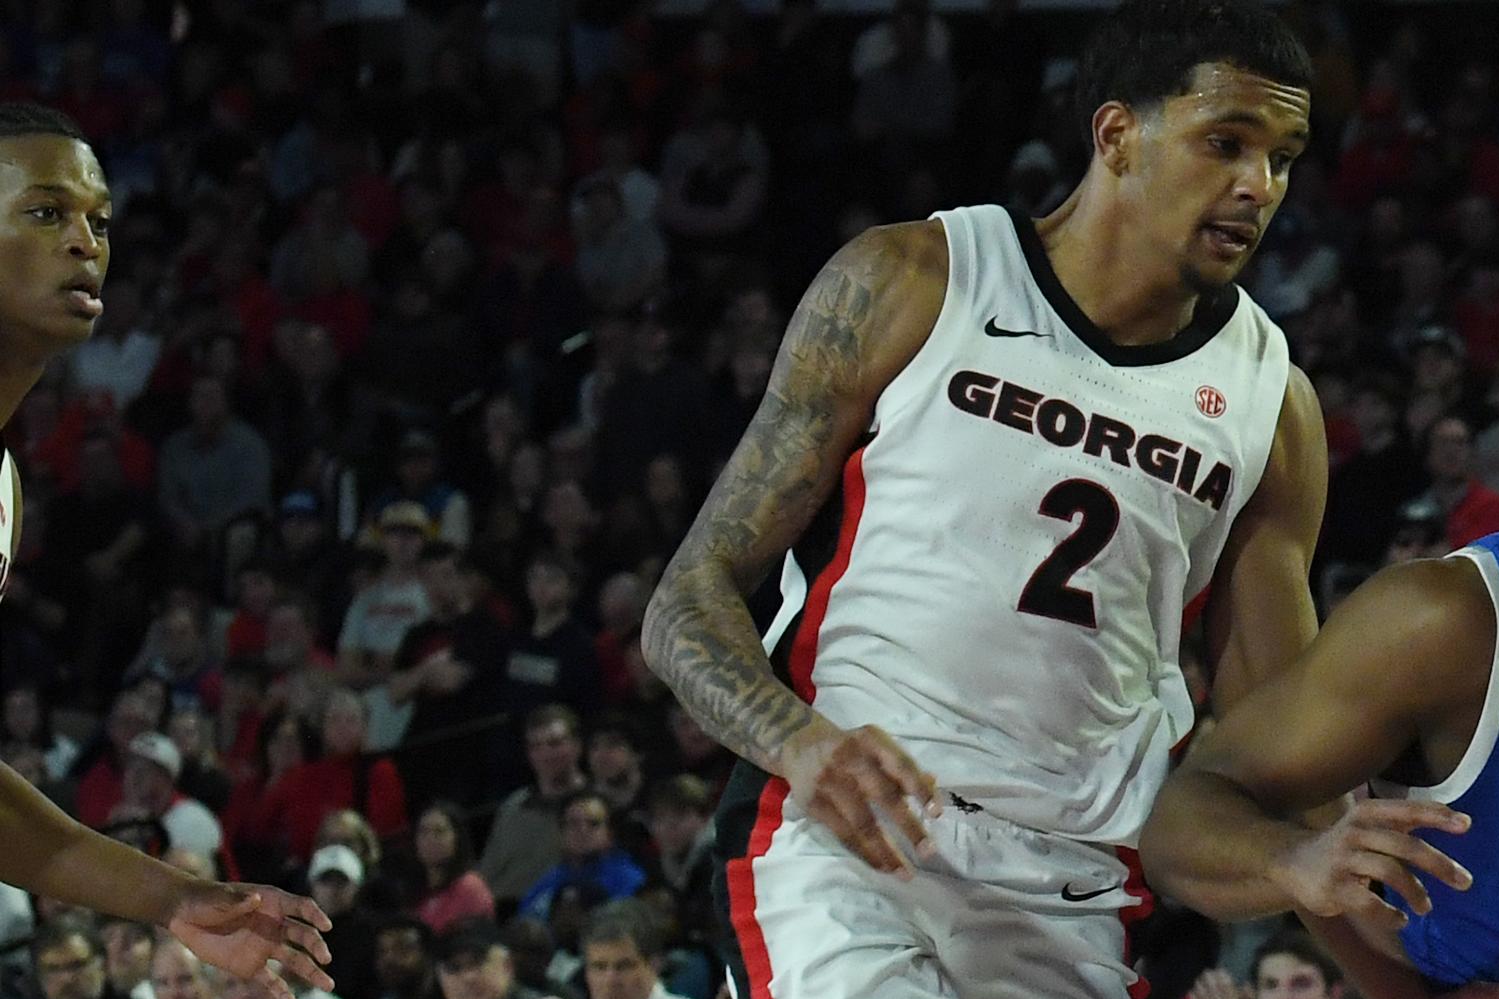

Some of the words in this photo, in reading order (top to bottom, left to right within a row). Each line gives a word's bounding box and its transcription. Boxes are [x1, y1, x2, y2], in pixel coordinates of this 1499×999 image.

[947, 370, 1232, 511] GEORGIA
[1197, 387, 1225, 416] SEC
[1016, 477, 1120, 629] 2
